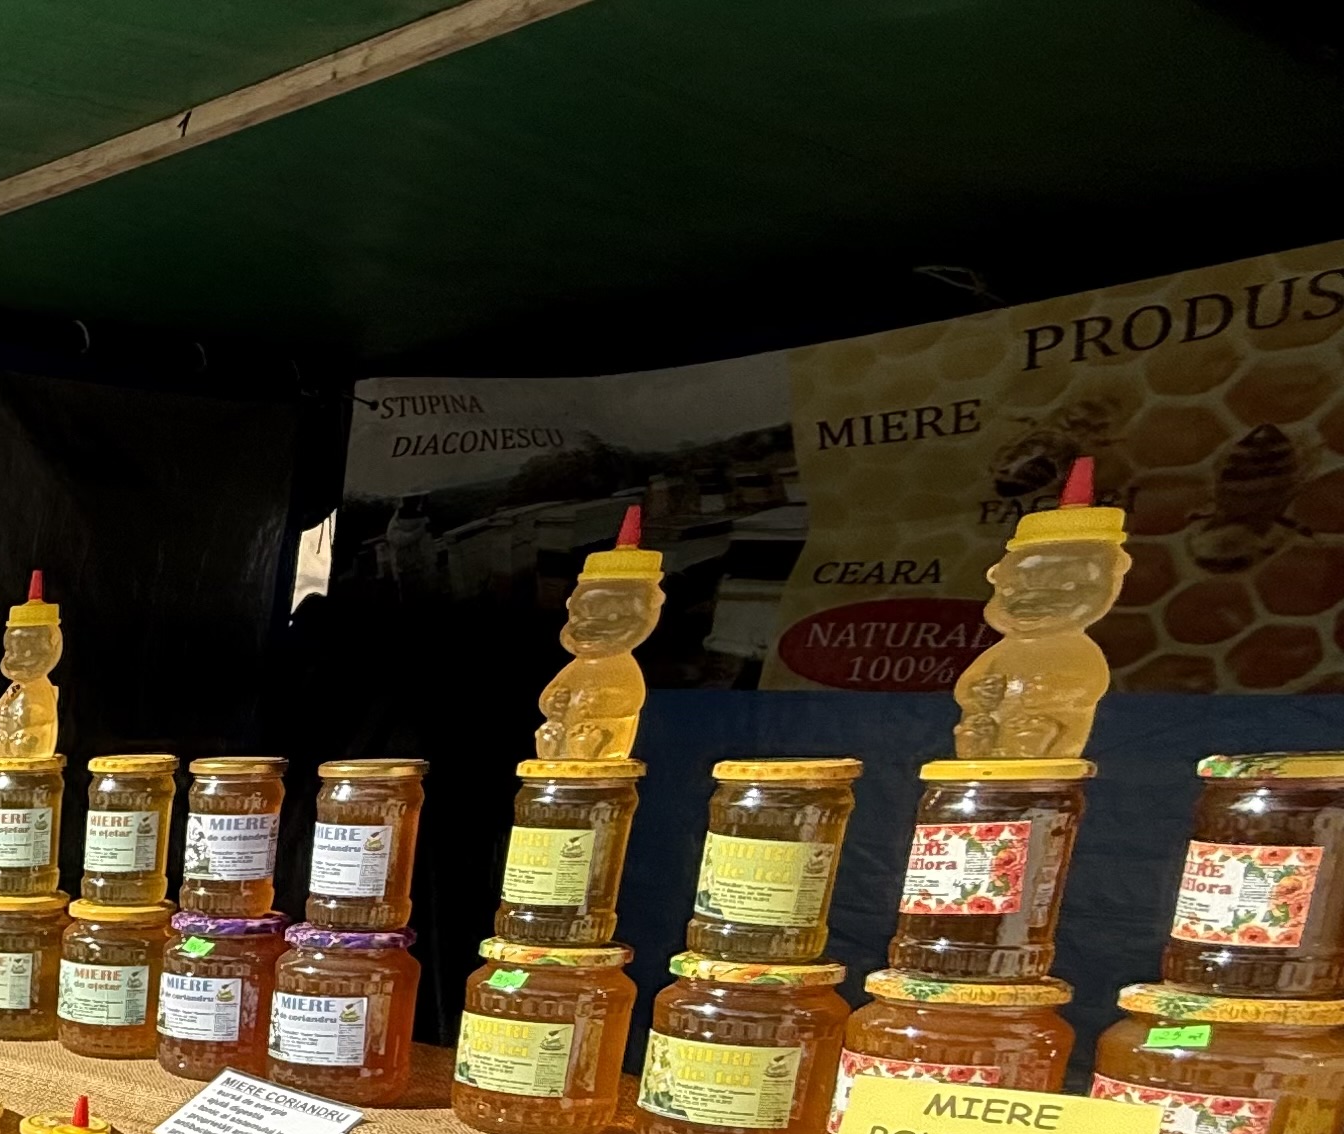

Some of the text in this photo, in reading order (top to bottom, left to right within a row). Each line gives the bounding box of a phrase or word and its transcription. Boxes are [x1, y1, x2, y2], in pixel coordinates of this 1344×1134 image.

[379, 394, 485, 420] STUPINA
[817, 399, 983, 451] MIERE
[391, 427, 564, 459] DIACONESCU
[812, 559, 942, 587] CEARA
[805, 621, 995, 652] NATURAL
[846, 654, 956, 686] 100%
[209, 817, 269, 830] MIERE
[74, 967, 123, 981] MIERE
[166, 976, 213, 992] MIERE
[280, 995, 337, 1012] MIERE
[220, 1077, 351, 1124] MIERE CORIANDRU
[923, 1092, 1064, 1131] MIERE
